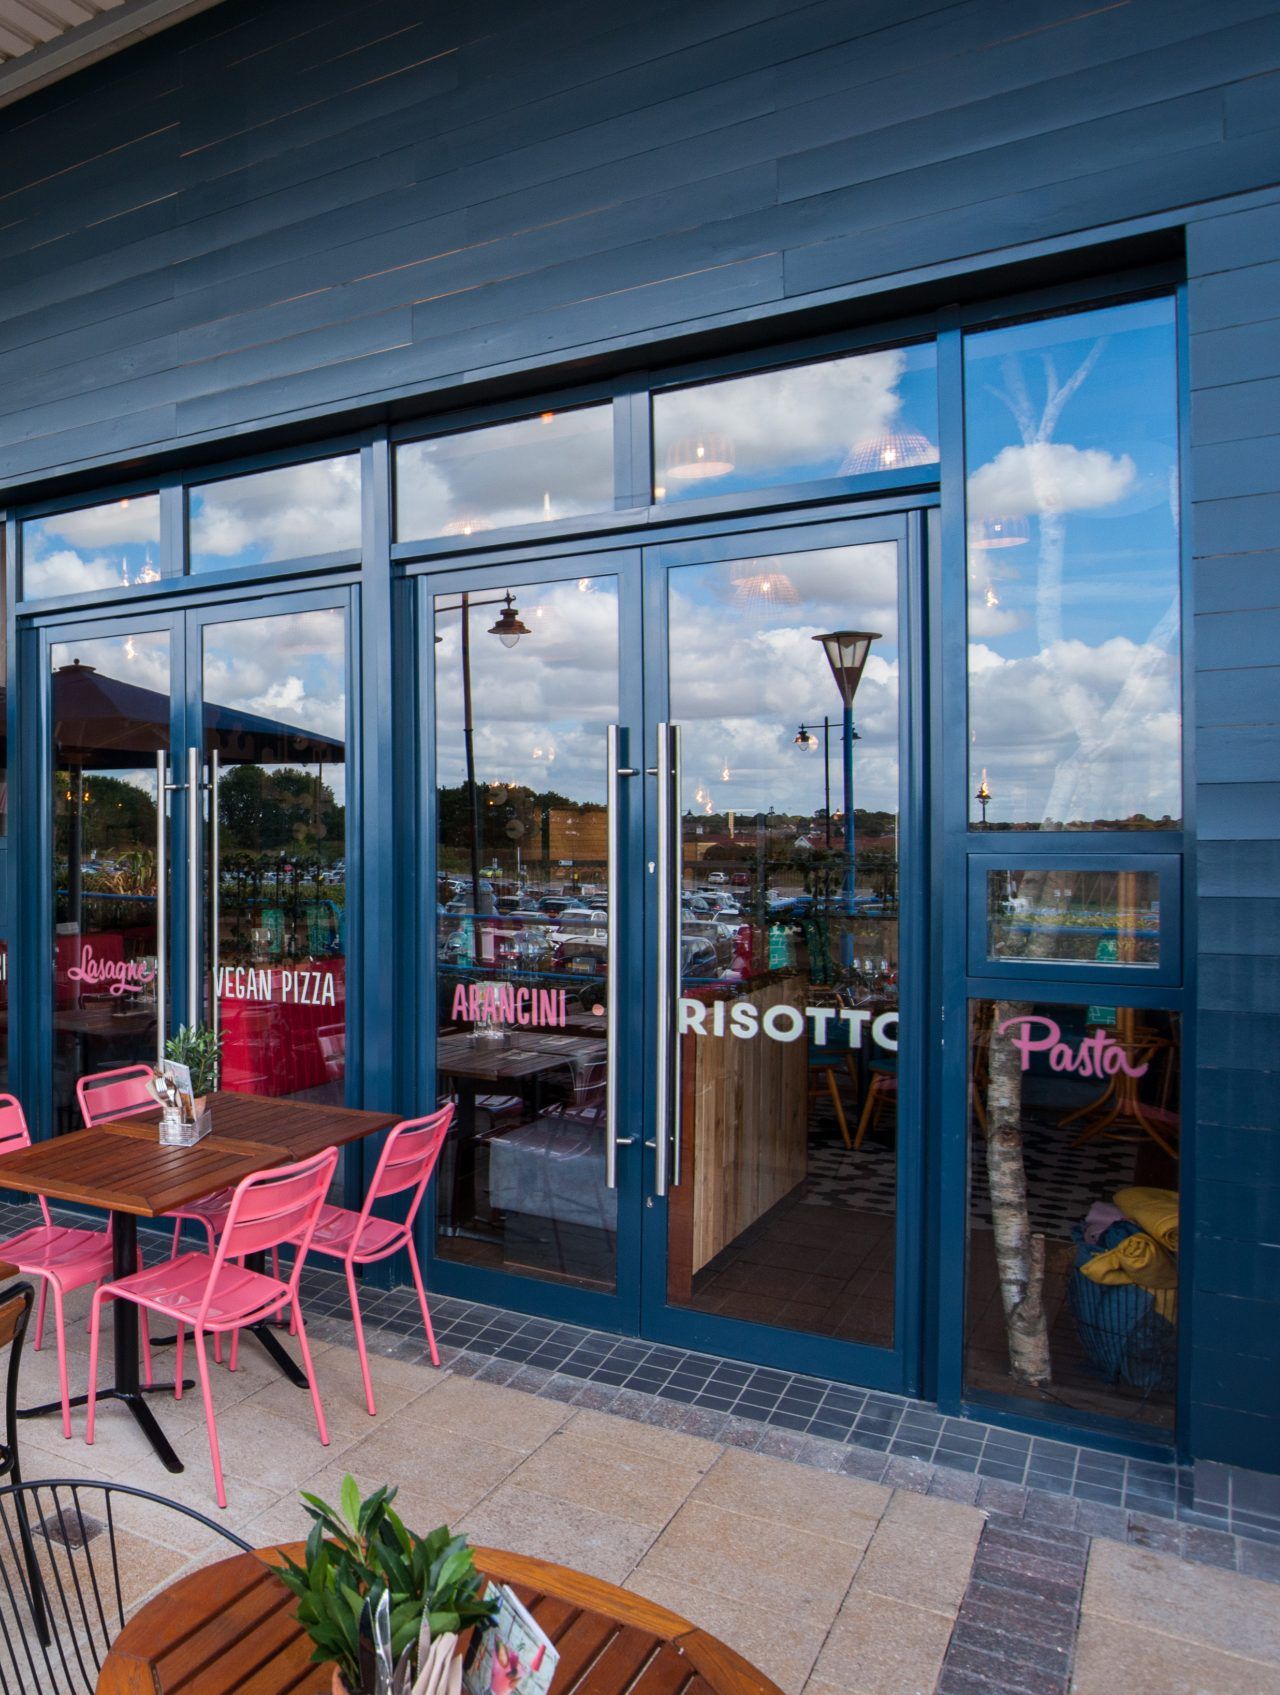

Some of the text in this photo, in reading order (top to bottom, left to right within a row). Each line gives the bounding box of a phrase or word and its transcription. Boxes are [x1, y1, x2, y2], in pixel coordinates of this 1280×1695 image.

[67, 944, 155, 996] Lasagne
[213, 966, 336, 1007] VEGAN PIZZA
[451, 983, 566, 1028] ARANCINI
[678, 997, 899, 1051] RISOTTO
[997, 1015, 1150, 1079] Pasta
